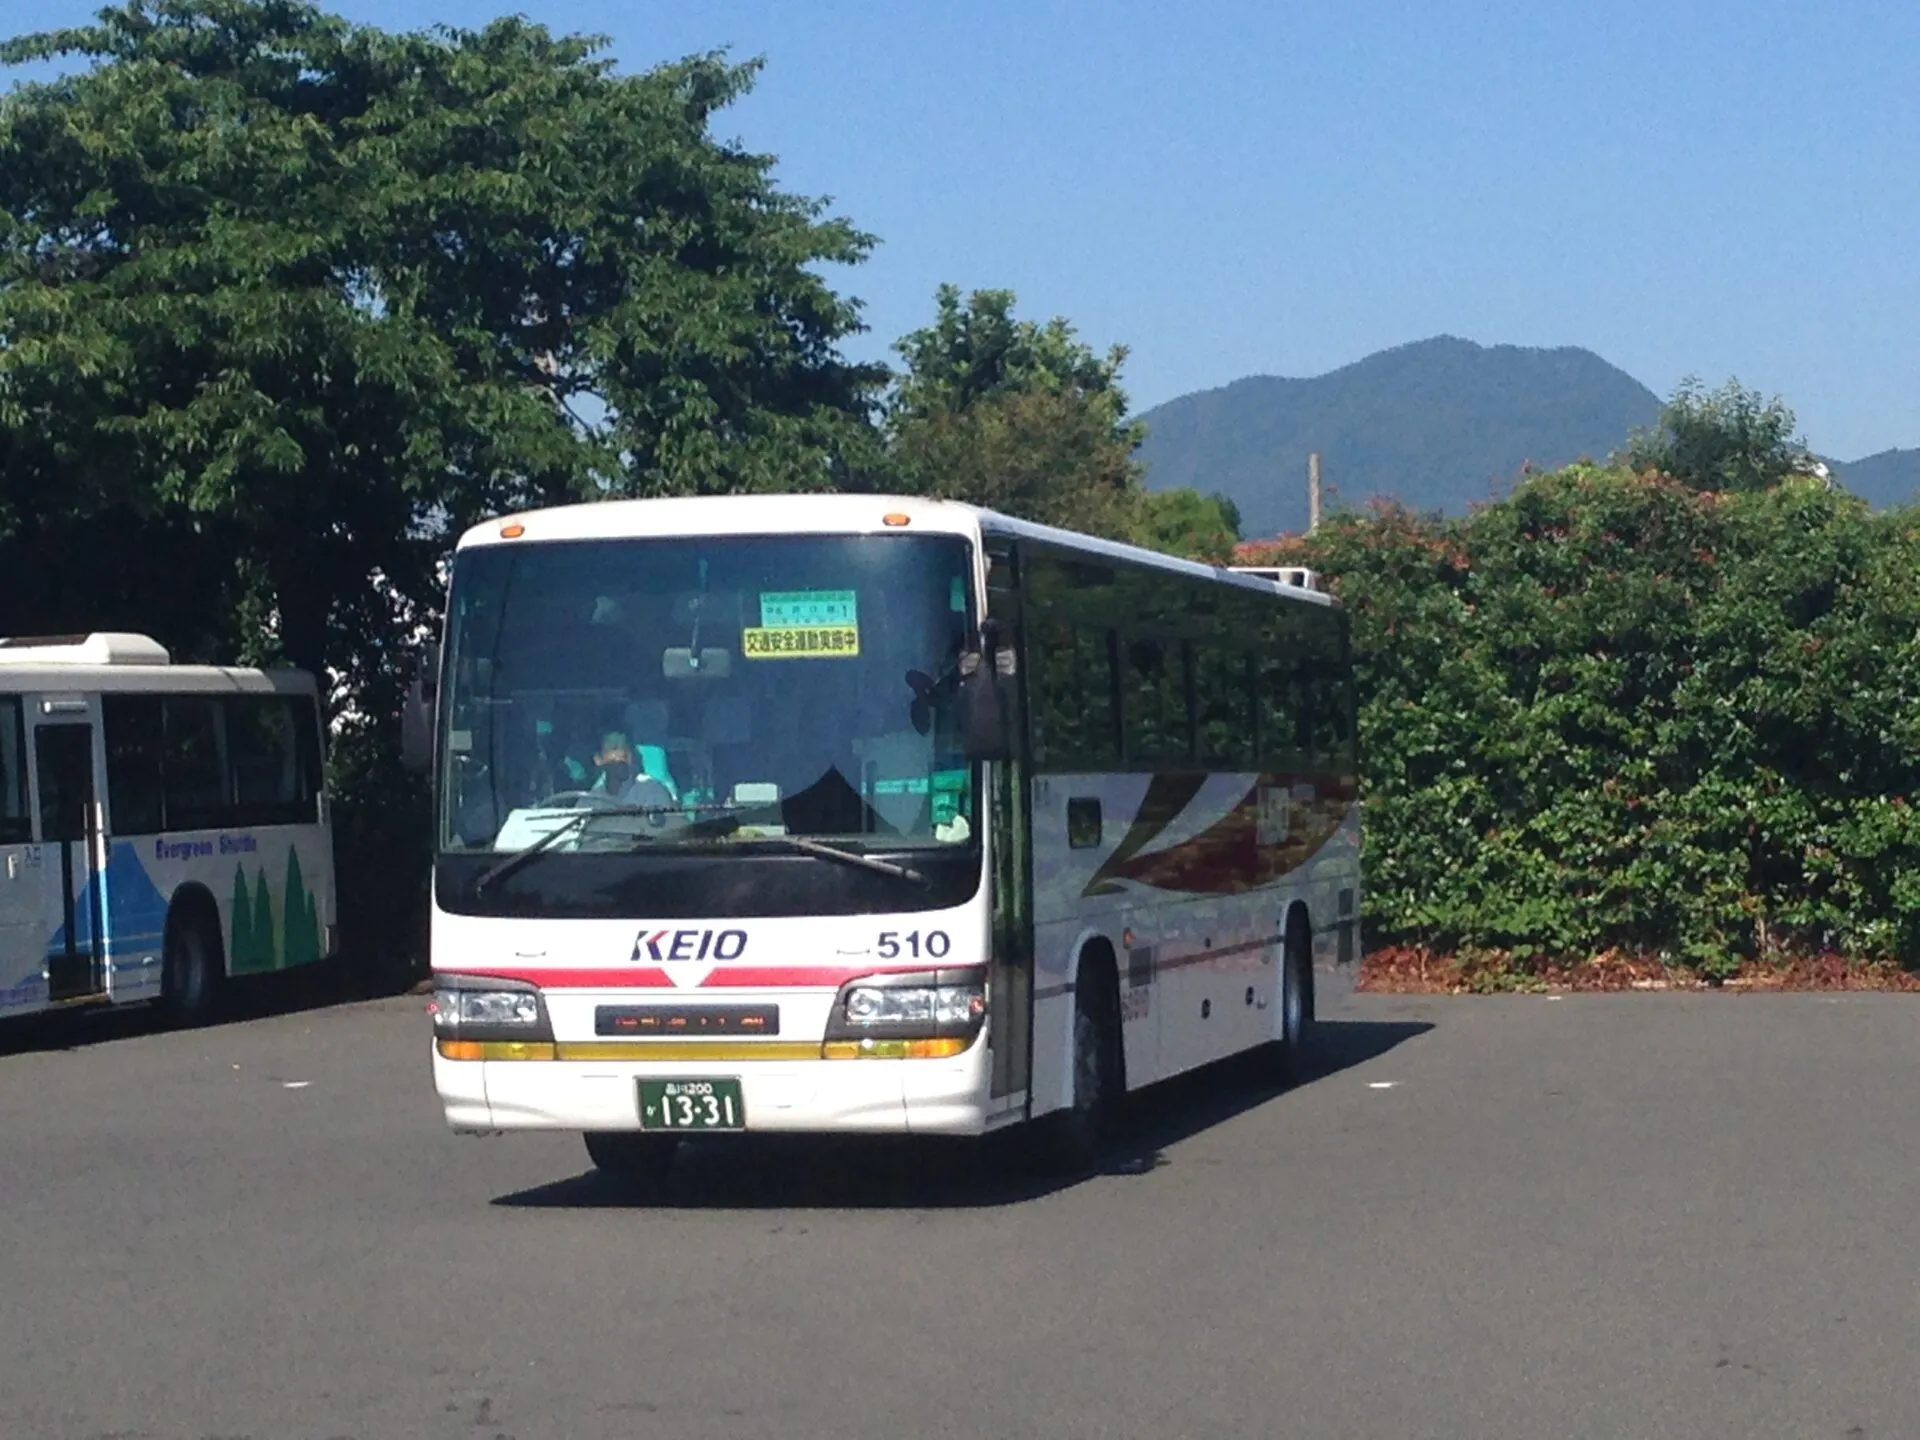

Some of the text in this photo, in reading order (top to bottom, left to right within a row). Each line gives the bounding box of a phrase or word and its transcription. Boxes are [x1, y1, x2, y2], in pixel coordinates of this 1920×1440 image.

[156, 838, 213, 861] Evergreen
[631, 930, 748, 961] KEIO
[877, 930, 950, 958] 510
